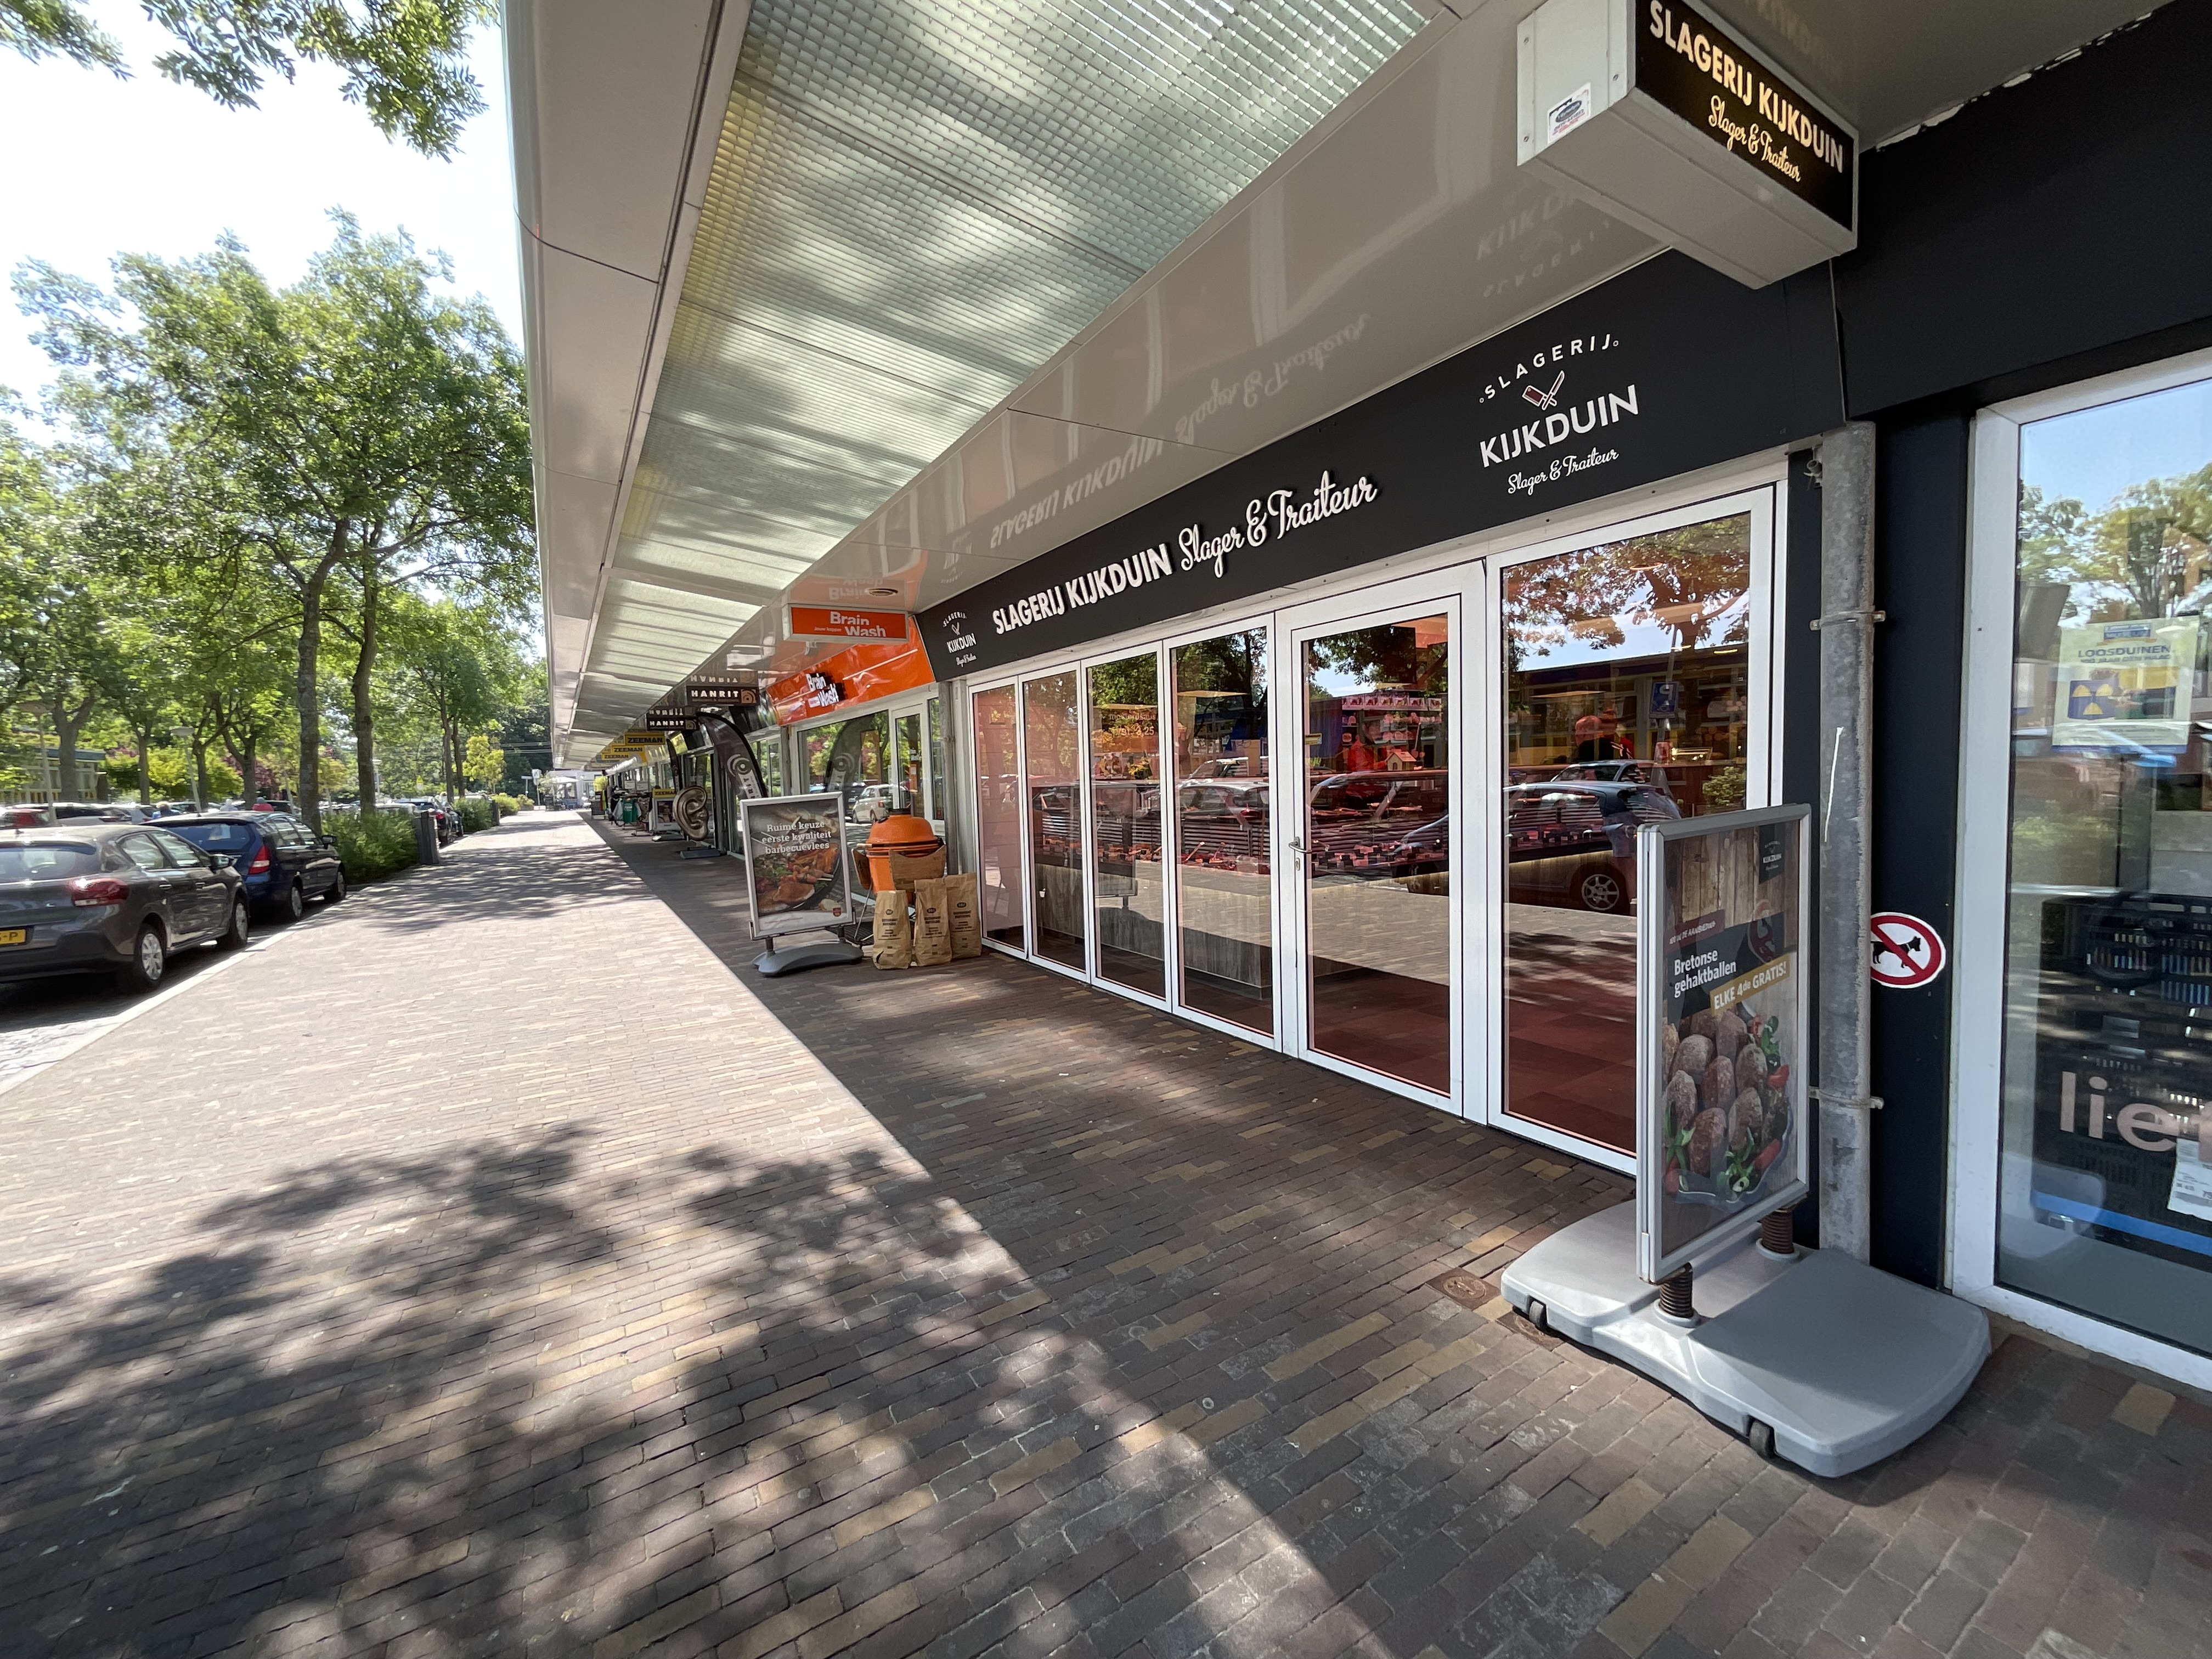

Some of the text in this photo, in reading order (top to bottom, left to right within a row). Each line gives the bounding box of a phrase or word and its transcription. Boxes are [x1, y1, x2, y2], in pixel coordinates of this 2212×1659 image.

[1649, 1, 1844, 173] SLAGERIJ KIJKDUIN
[1708, 95, 1801, 183] Slager & Traiteur
[1484, 334, 1611, 399] SLAGERIJ
[1480, 384, 1639, 467] KIJKDUIN
[1508, 447, 1619, 495] Slager & Traiteur
[992, 471, 1378, 635] SLAGERIJ KIJKDUIN Slager & Traiteur
[831, 611, 869, 625] Brain
[844, 625, 887, 637] Wash
[947, 633, 976, 653] KIJKDUIN
[2078, 645, 2171, 657] LOOSDUINEN
[806, 673, 826, 691] Brain
[817, 683, 839, 707] Wash
[767, 823, 796, 832] Ruime
[792, 831, 831, 840] kwaliteit
[765, 843, 830, 854] barbecuevlees
[1674, 950, 1718, 975] Bretonse
[1674, 961, 1736, 998] gehaktballen
[1714, 961, 1786, 1009] ELKE 4de GRATIS!
